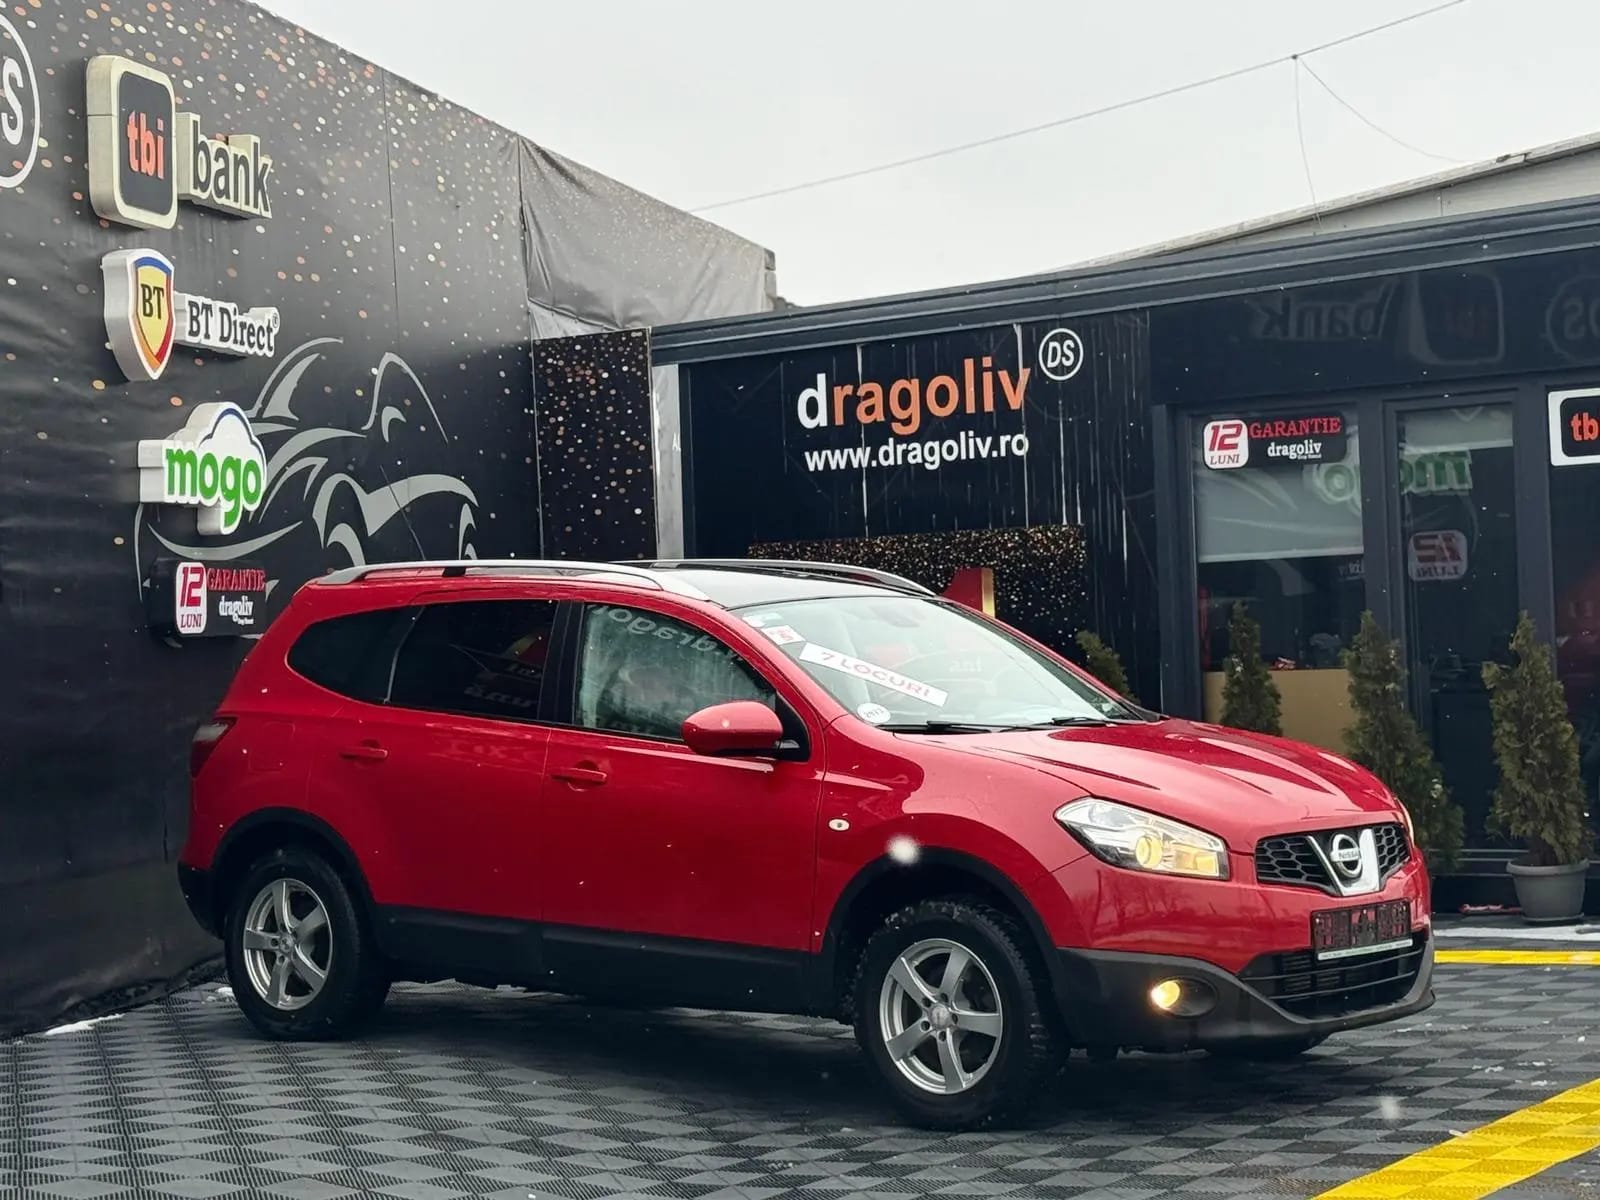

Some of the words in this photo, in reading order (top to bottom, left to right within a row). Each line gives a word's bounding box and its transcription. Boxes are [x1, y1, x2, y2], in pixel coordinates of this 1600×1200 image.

[126, 110, 165, 180] tbi
[192, 119, 270, 213] bank
[141, 283, 164, 320] BT
[188, 300, 213, 340] BT
[219, 307, 273, 352] Direct
[1046, 339, 1075, 368] DS
[797, 356, 1031, 435] dragoliv
[1208, 423, 1243, 452] 12
[1249, 417, 1342, 439] GARANTIE
[805, 430, 1030, 472] www.dragoliv.ro
[1210, 454, 1240, 466] LUNI
[1267, 439, 1322, 460] dragoliv
[165, 447, 263, 528] mogo
[180, 566, 204, 607] 12
[206, 567, 266, 591] GARANTIE
[181, 613, 202, 629] LUNI
[219, 595, 253, 622] dragoliv
[821, 651, 835, 661] 7
[839, 657, 931, 697] LOCURI
